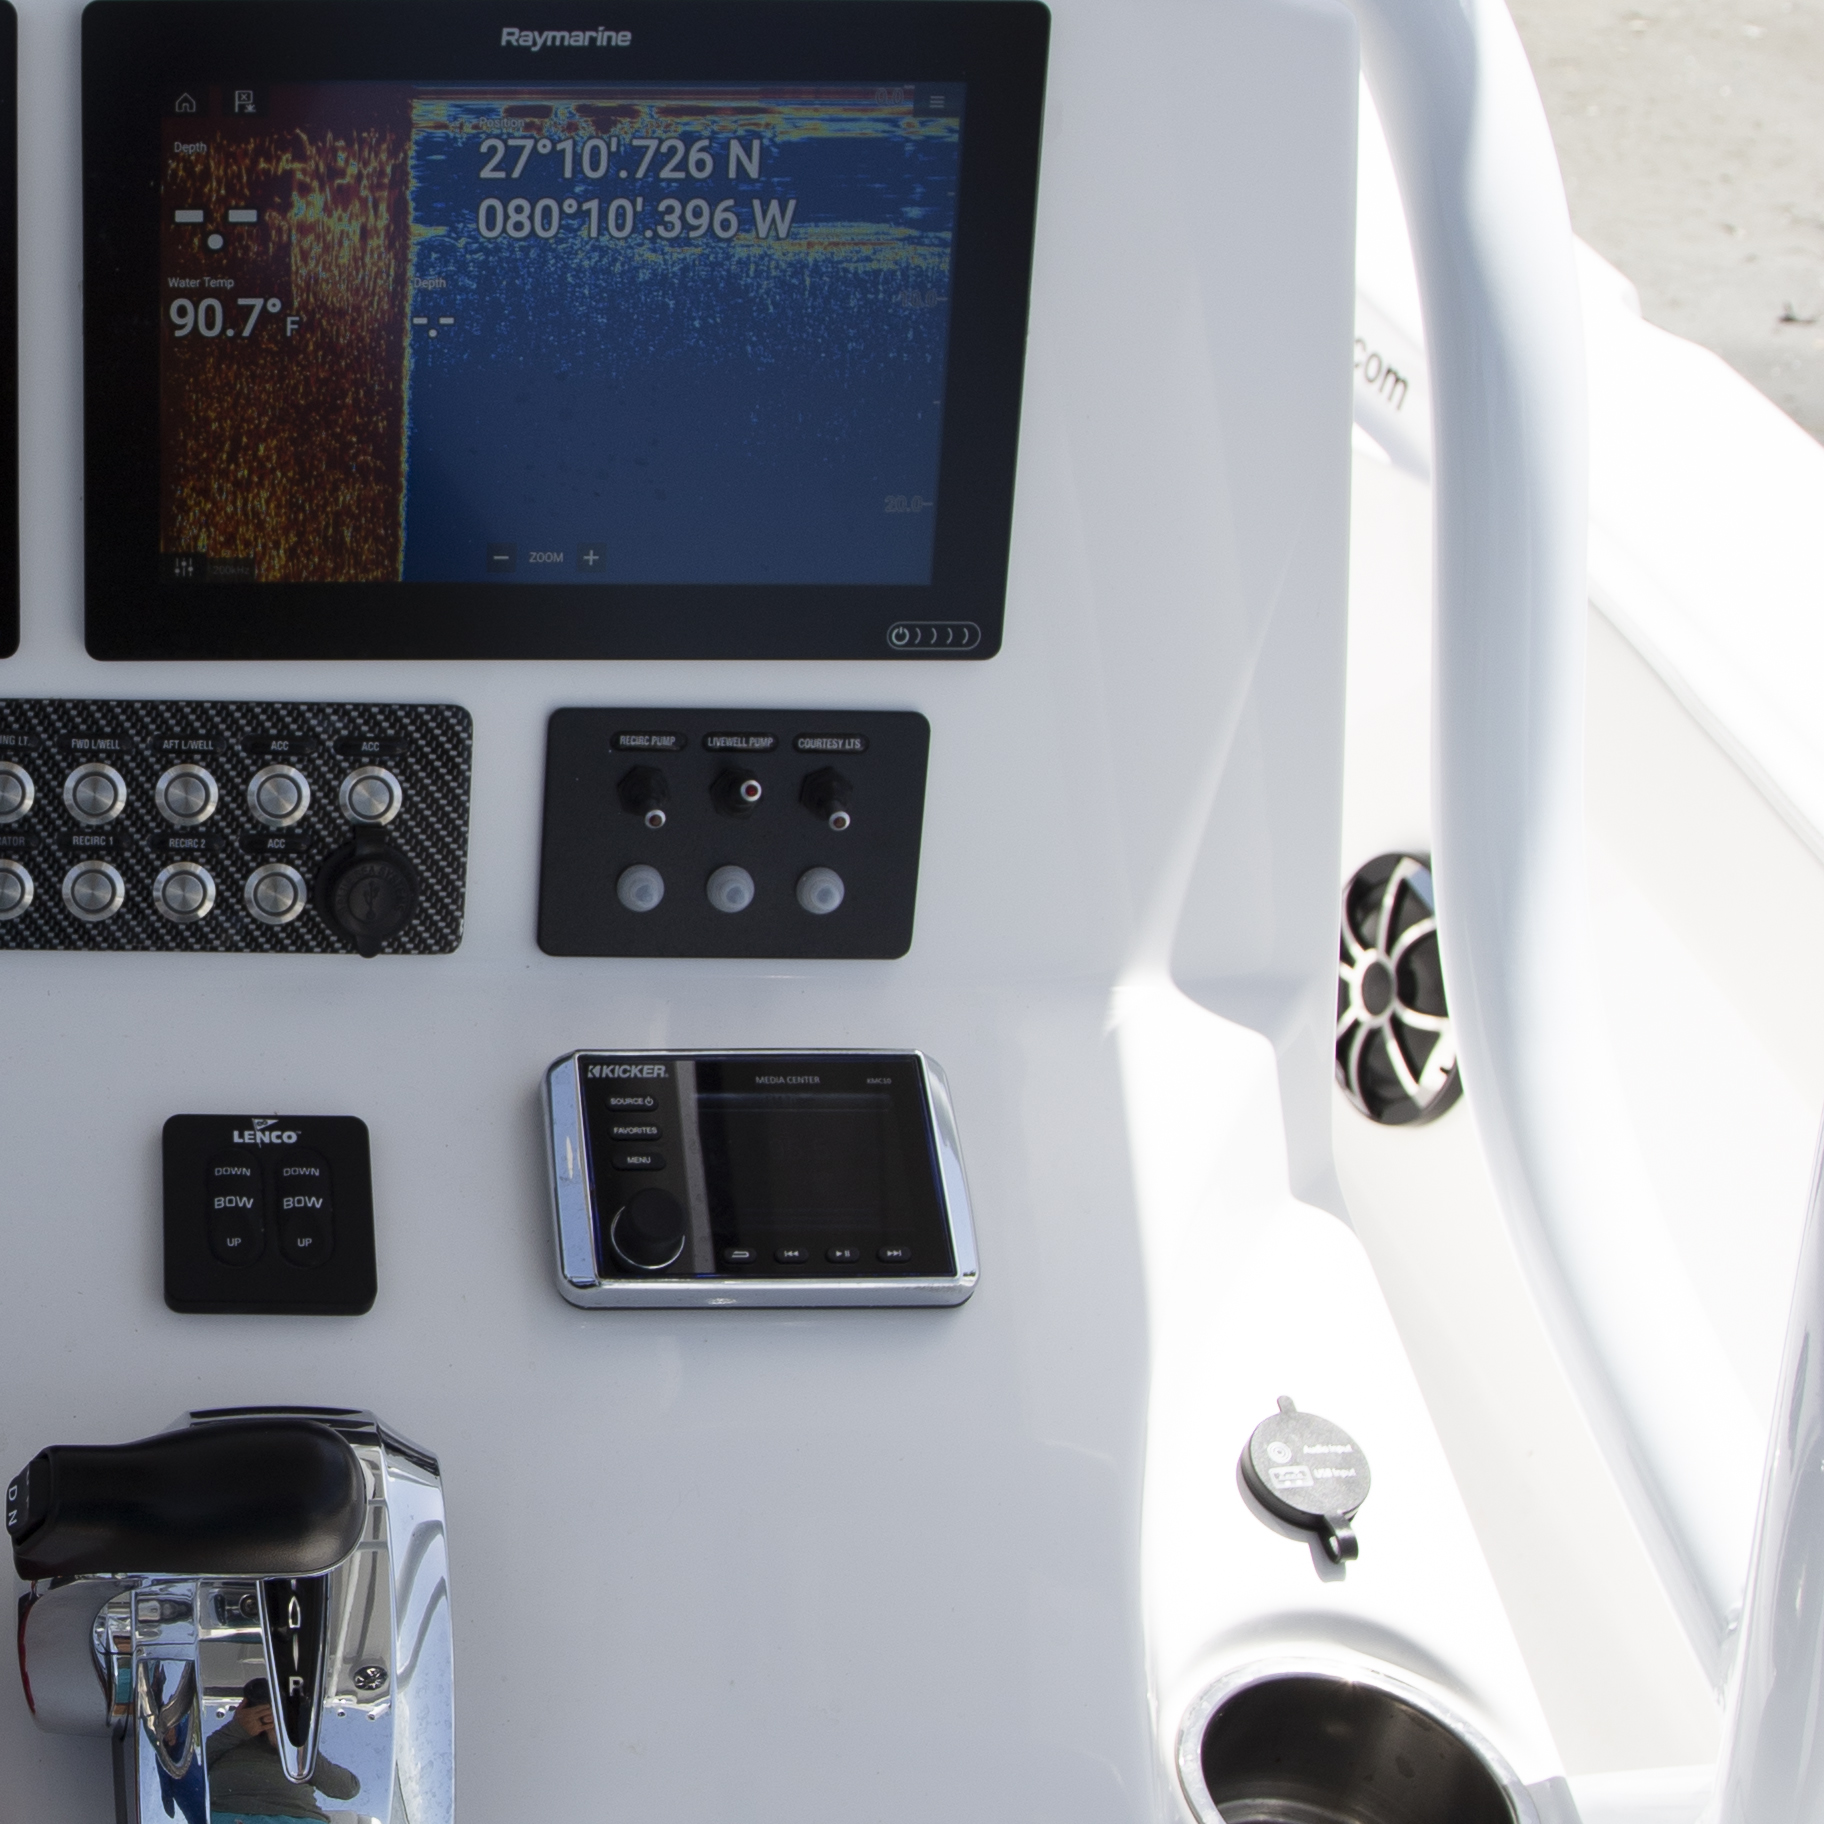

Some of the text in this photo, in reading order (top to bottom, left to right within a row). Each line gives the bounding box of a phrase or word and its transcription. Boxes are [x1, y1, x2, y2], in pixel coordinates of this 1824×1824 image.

[500, 24, 633, 52] Raymarine
[478, 116, 527, 131] Position
[173, 141, 207, 156] Depth
[729, 139, 762, 180] N
[750, 197, 797, 241] W
[167, 277, 235, 291] Water Temp
[413, 277, 447, 291] Depth
[528, 551, 565, 563] ZOOM
[71, 738, 120, 750] FWD L/WELL
[162, 739, 214, 751] AFT L/WELL
[270, 740, 289, 751] ACC
[361, 741, 380, 752] ACC
[619, 735, 676, 747] RECIRC PUMP
[707, 736, 774, 748] LIVEWELL PUMP
[797, 737, 862, 750] COURTESY LTS
[72, 835, 114, 846] RECIRC 1
[169, 838, 206, 850] RECIRC 2
[267, 839, 286, 850] ACC
[601, 1064, 667, 1079] KICKER
[755, 1075, 821, 1085] MEDIA CENTER
[610, 1096, 644, 1107] SOURCE
[613, 1125, 658, 1136] FAVORITES
[233, 1130, 298, 1144] LENCO
[626, 1155, 652, 1166] MENU
[215, 1166, 251, 1176] DOWN
[283, 1166, 320, 1177] DOWN
[214, 1195, 254, 1210] BOW
[282, 1195, 323, 1210] BOW
[227, 1236, 242, 1248] UP
[297, 1236, 312, 1248] UP
[288, 1676, 305, 1697] R
